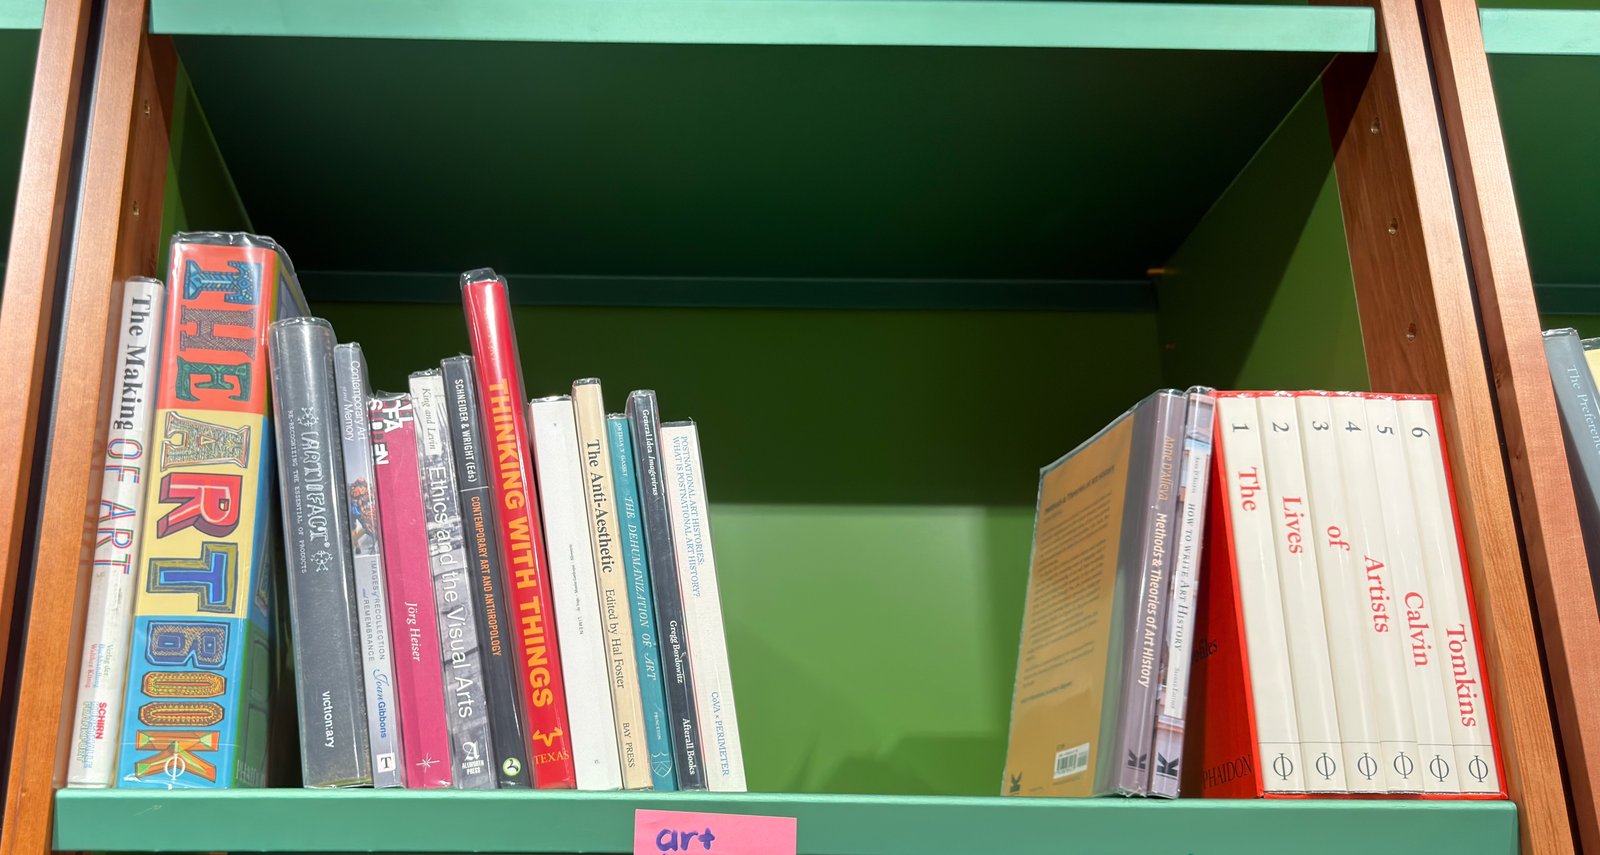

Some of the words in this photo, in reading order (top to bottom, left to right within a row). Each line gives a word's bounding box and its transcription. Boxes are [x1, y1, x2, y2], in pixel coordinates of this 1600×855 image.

[129, 294, 152, 337] The
[176, 259, 262, 401] THE
[112, 344, 148, 431] Making
[350, 360, 365, 425] Contemporary
[1567, 364, 1581, 390] The
[421, 388, 432, 408] King
[454, 378, 469, 423] SCHNEIDER
[343, 403, 355, 442] Memory
[425, 410, 436, 424] and
[643, 409, 652, 437] General
[1232, 422, 1250, 433] 1
[1272, 421, 1290, 433] 2
[1312, 420, 1330, 432] 3
[1345, 420, 1362, 432] 4
[1376, 424, 1394, 436] 5
[1411, 426, 1431, 438] 6
[357, 426, 368, 441] Art
[427, 428, 438, 450] Levin
[462, 429, 474, 461] WRIGHT
[489, 377, 525, 511] THINKING
[646, 438, 654, 453] Idea
[673, 436, 684, 463] WHAT
[1162, 435, 1175, 460] Anne
[104, 437, 144, 484] OF
[587, 438, 600, 468] The
[681, 435, 696, 499] POSTNATIONAL
[466, 462, 477, 483] (Eds)
[428, 466, 448, 523] Ethics
[677, 472, 692, 537] POSTNATIONAL
[1238, 466, 1262, 512] The
[146, 410, 251, 614] ART
[590, 472, 616, 574] Anti-Aesthetic
[624, 496, 636, 519] THE
[690, 500, 699, 517] ART
[1186, 503, 1196, 529] HOW
[94, 499, 137, 575] ART
[470, 496, 488, 558] CONTEMPORARY
[1152, 512, 1167, 560] Methods
[1184, 530, 1193, 542] TO
[1282, 496, 1304, 554] Lives
[1327, 525, 1350, 552] of
[298, 540, 308, 574] PRODUCTS
[437, 528, 457, 566] and
[507, 515, 537, 590] WITH
[685, 537, 695, 554] ART
[691, 518, 705, 566] HISTORIES:
[370, 560, 379, 591] IMAGES
[479, 558, 490, 575] ART
[628, 522, 650, 628] DEHUMANIZATION
[688, 556, 701, 598] HISTORY?
[1151, 558, 1161, 568] &
[1180, 545, 1191, 578] WRITE
[442, 571, 460, 602] the
[482, 575, 493, 592] AND
[1146, 569, 1162, 615] Theories
[1177, 580, 1190, 602] ART
[1363, 554, 1391, 633] Artists
[404, 601, 418, 625] Jörg
[605, 588, 618, 621] Edited
[363, 598, 375, 662] REMEMBRANCE
[374, 598, 386, 661] RECOLLECTION
[447, 606, 471, 669] Visual
[484, 593, 502, 657] ANTHROPOLOGY
[607, 621, 619, 634] by
[669, 620, 679, 643] Gregg
[1143, 629, 1156, 646] Art
[1145, 615, 1158, 629] of
[1174, 604, 1189, 652] HISTORY
[1403, 591, 1432, 668] Calvin
[409, 627, 421, 662] Heiser
[519, 596, 554, 708] THINGS
[611, 638, 622, 657] Hal
[641, 633, 652, 649] OF
[613, 658, 625, 689] Foster
[643, 652, 656, 681] ART
[673, 644, 685, 684] Bordowitz
[1137, 647, 1155, 688] History
[1446, 623, 1478, 728] Tomkins
[372, 669, 390, 700] Joan
[454, 676, 476, 718] Arts
[135, 620, 231, 783] BOOK
[95, 701, 108, 740] SCHIRN
[377, 701, 388, 739] Gibbons
[623, 722, 632, 738] BAY
[682, 718, 694, 750] Afterall
[533, 750, 570, 766] TEXAS
[625, 742, 636, 768] PRESS
[686, 750, 697, 775] Books
[715, 720, 730, 777] PERIMETER
[1202, 754, 1253, 790] PHAIDON
[655, 827, 716, 852] art
